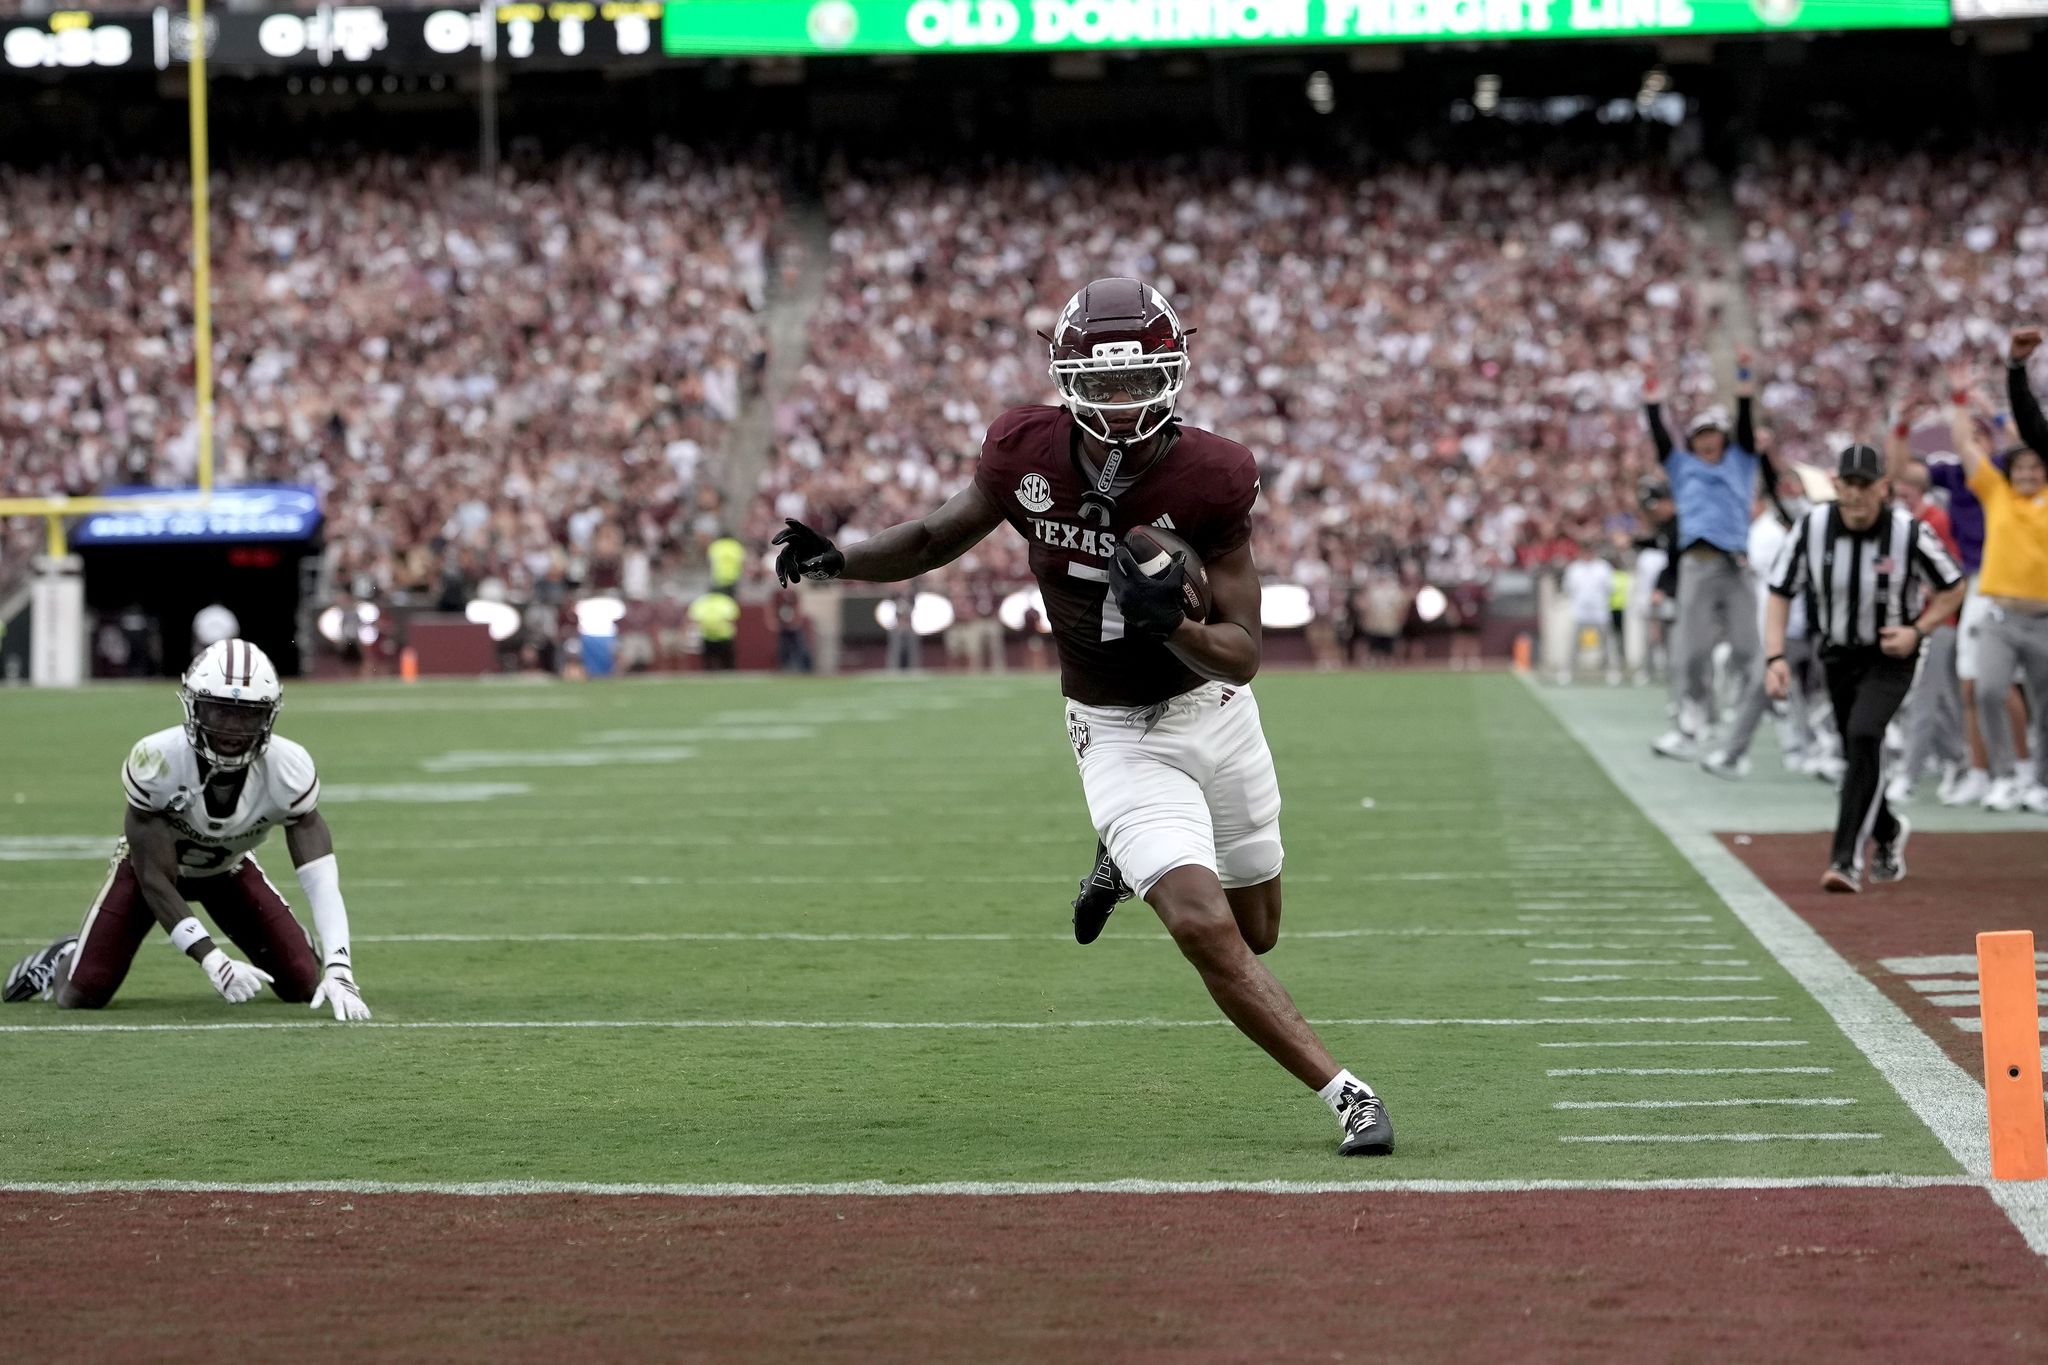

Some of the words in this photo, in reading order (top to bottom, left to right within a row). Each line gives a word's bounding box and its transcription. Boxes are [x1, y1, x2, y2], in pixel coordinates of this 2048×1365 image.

[906, 0, 1020, 46] OLD
[1031, 0, 1307, 43] DOMINION
[1324, 0, 1553, 36] FREIGHT
[1569, 0, 1694, 29] LINE
[1023, 475, 1048, 503] SEC
[1100, 452, 1120, 489] BATTLE
[1026, 516, 1116, 558] TEXAS
[1068, 560, 1125, 642] 7
[1182, 582, 1200, 608] DIME
